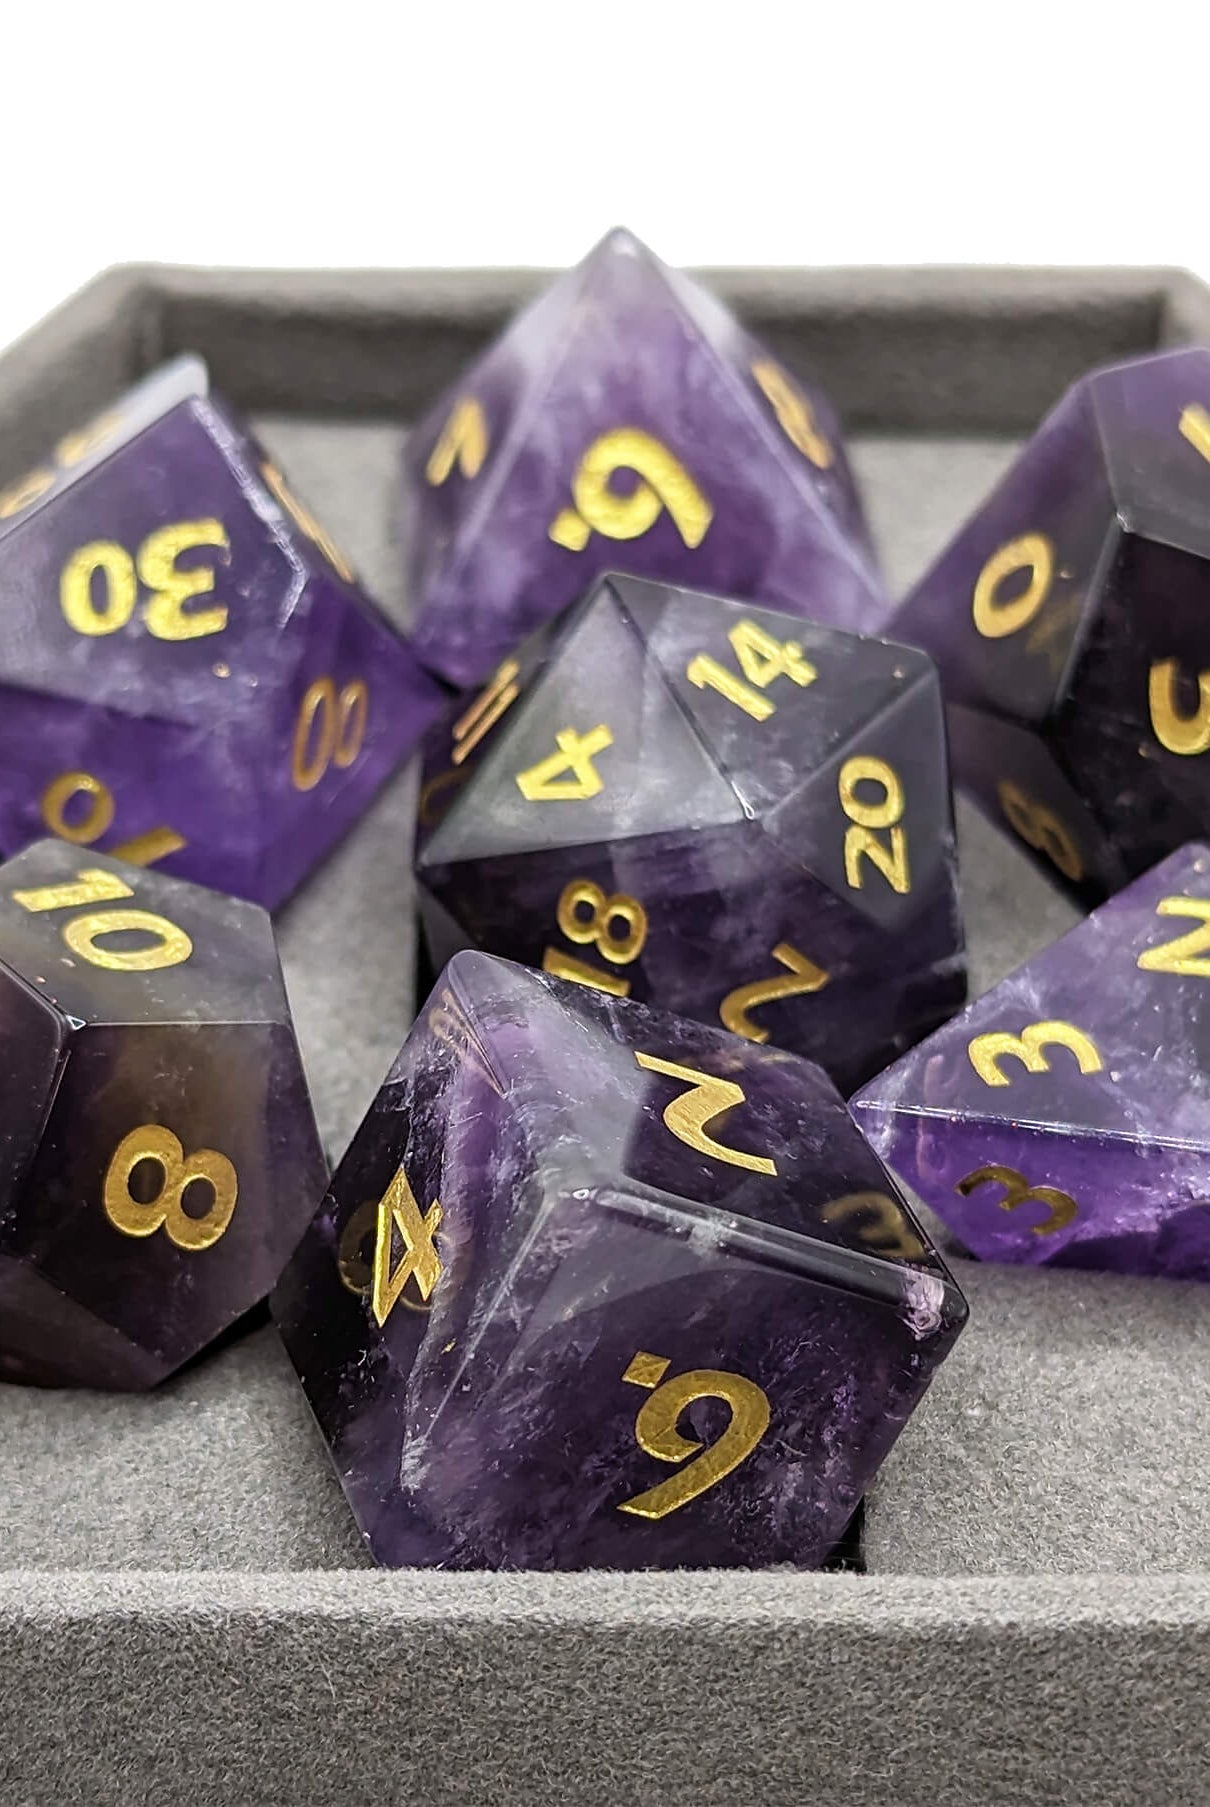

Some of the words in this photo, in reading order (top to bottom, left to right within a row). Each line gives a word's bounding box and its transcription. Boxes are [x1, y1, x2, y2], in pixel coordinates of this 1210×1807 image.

[60, 518, 230, 641] 30
[687, 619, 817, 722] 14
[292, 677, 367, 791] 00
[515, 724, 613, 802] 4
[839, 756, 911, 895] 20
[13, 869, 193, 971] 10
[542, 879, 648, 997] 18
[968, 1020, 1104, 1087] 3
[105, 1123, 239, 1251] 8
[954, 1165, 1079, 1236] 3
